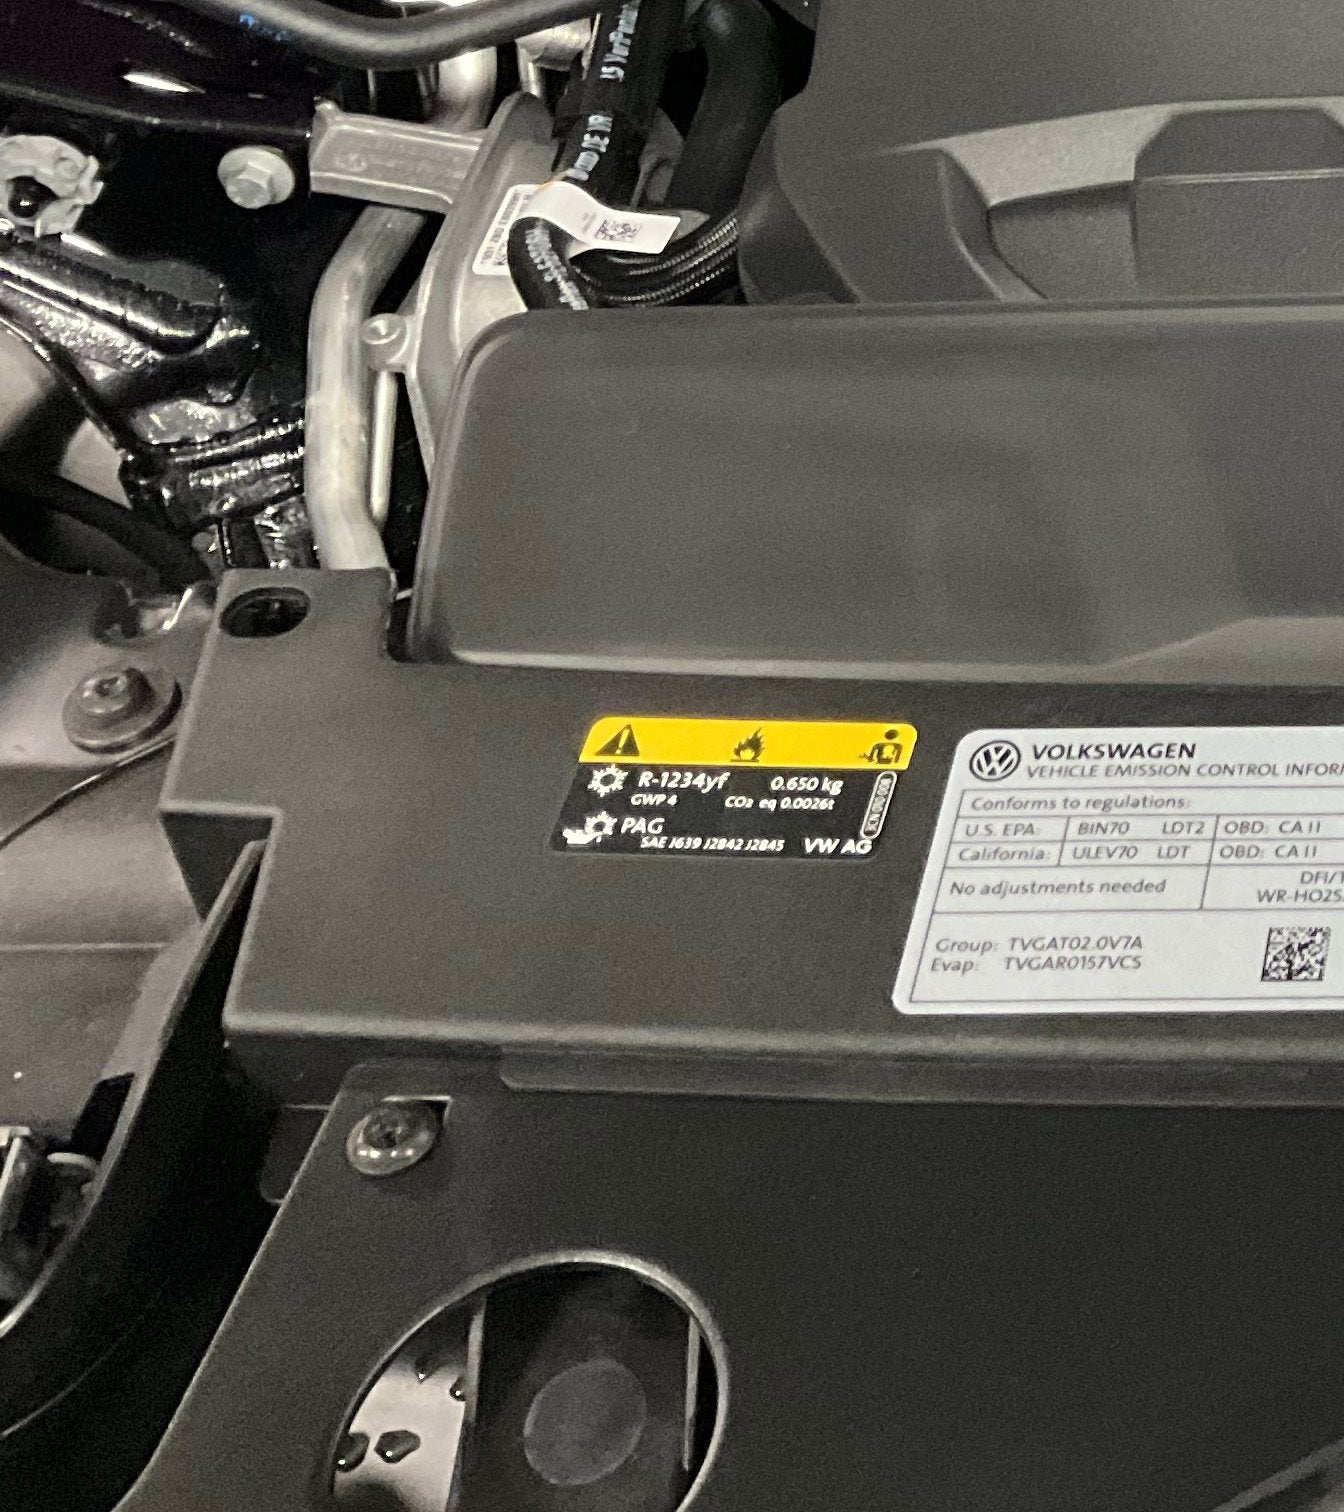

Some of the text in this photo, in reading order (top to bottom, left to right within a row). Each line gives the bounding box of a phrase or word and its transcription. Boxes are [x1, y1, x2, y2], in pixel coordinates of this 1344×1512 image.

[1032, 743, 1196, 760] VOLKSWAGEN
[1027, 764, 1098, 778] VEHICLE
[1104, 764, 1190, 778] EMISSION
[1197, 763, 1279, 777] CONTROL
[637, 771, 844, 796] R-1234yf 0.650 kg
[630, 794, 667, 806] GWP
[759, 798, 777, 812] eq
[971, 797, 1057, 810] Conforms
[1063, 797, 1080, 809] to
[621, 817, 666, 834] PAG
[1078, 821, 1205, 835] BIN70 LDT2
[1278, 820, 1304, 834] CA
[640, 836, 668, 849] SAE
[803, 837, 872, 855] VW AG
[1072, 845, 1190, 860] ULEV70 LDT
[1275, 844, 1300, 858] CA
[950, 878, 1166, 899] No adjustments needed
[936, 938, 998, 956] Group:
[931, 958, 978, 975] Evap:
